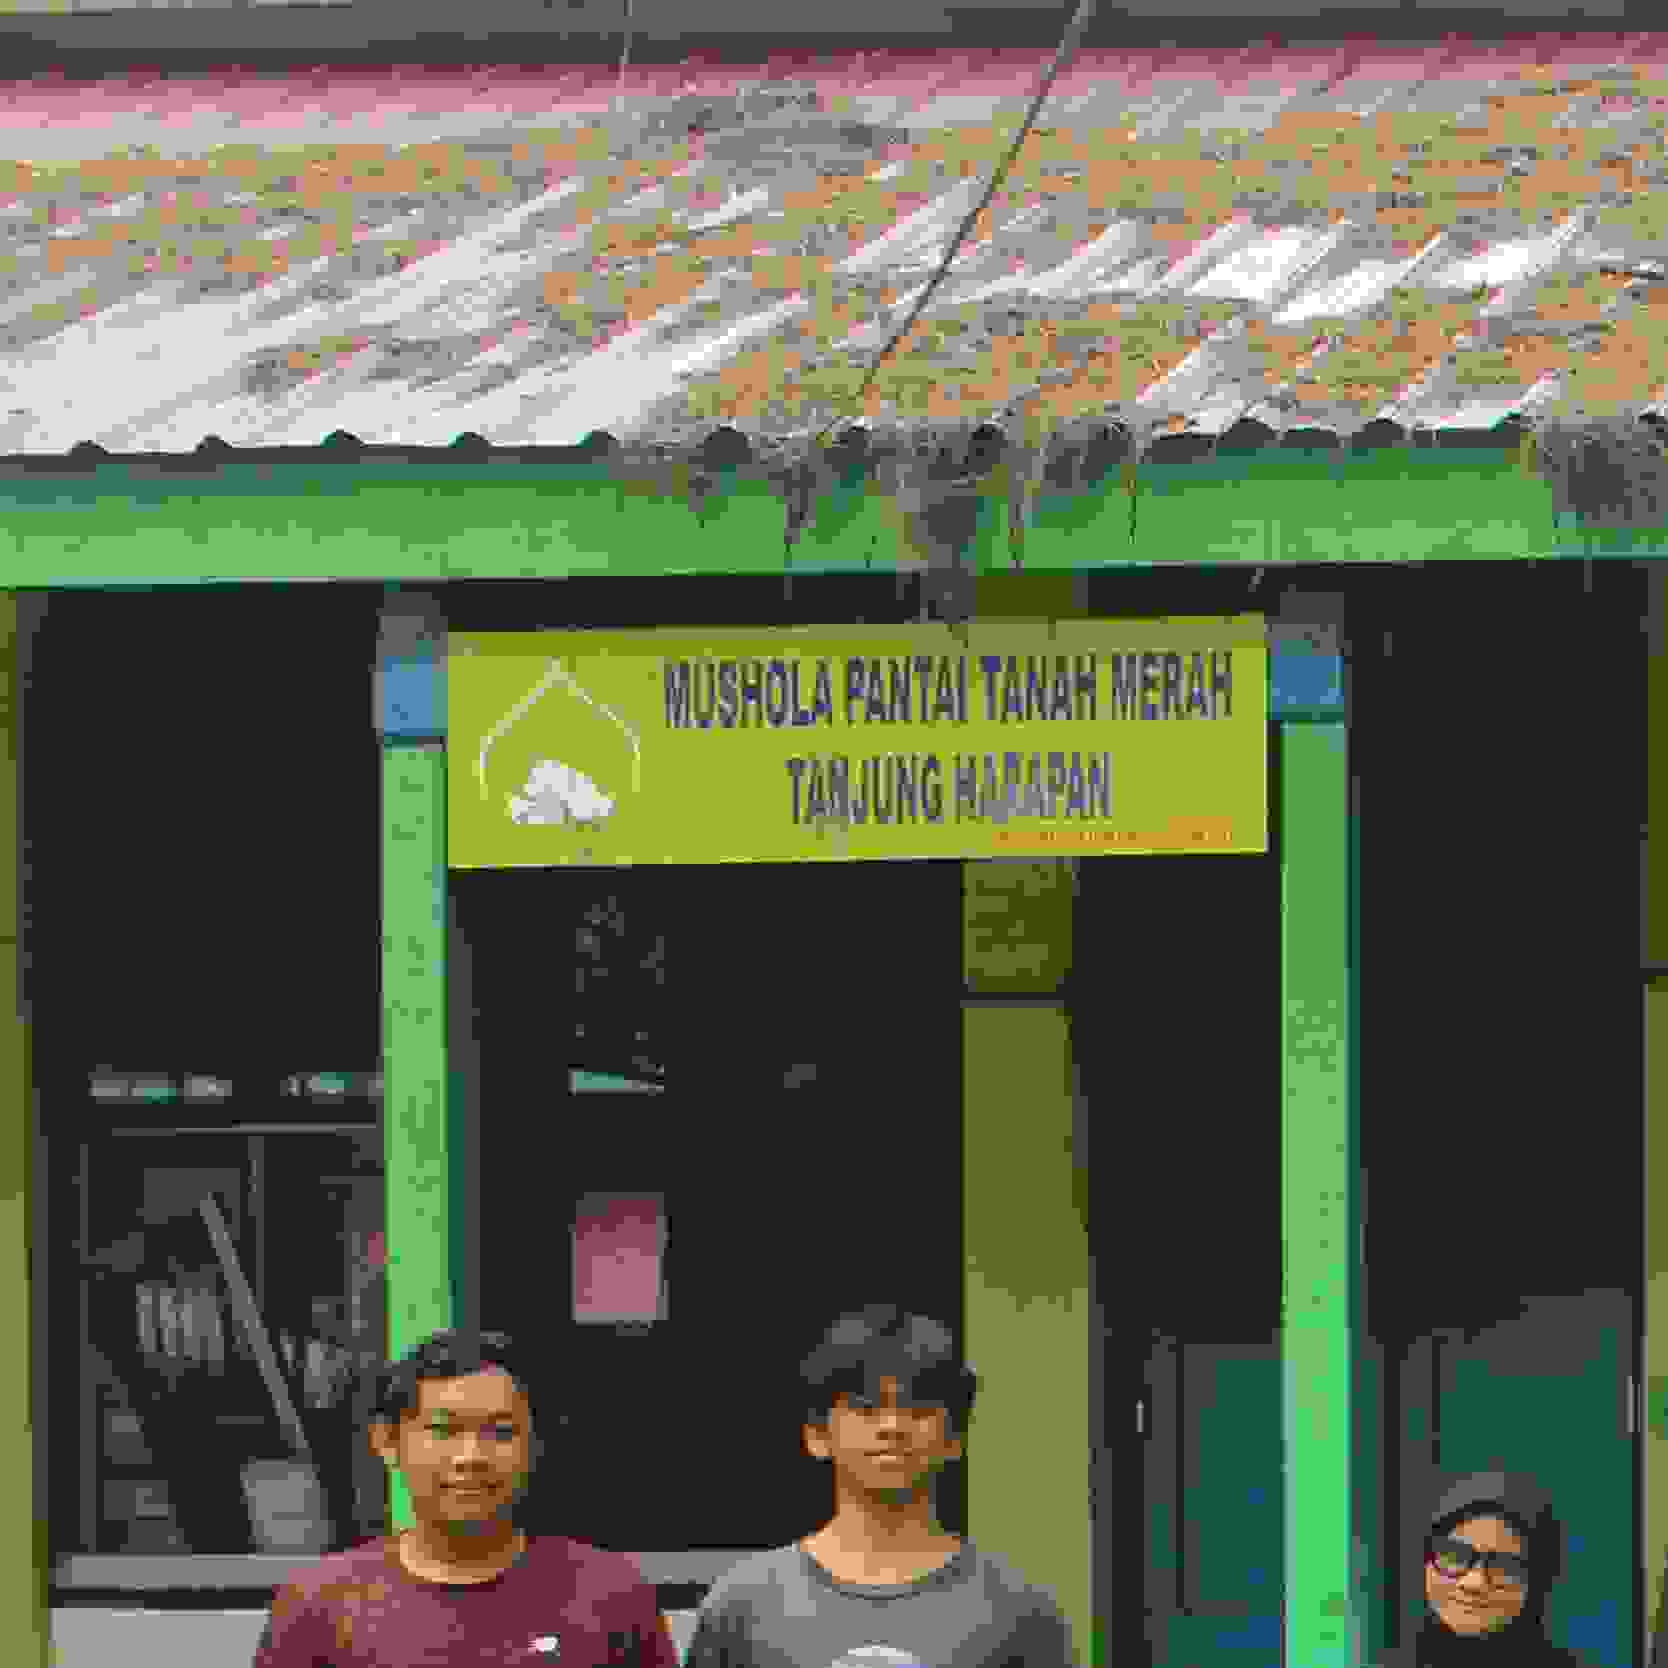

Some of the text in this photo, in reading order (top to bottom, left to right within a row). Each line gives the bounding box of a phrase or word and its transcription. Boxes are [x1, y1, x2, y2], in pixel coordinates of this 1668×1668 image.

[664, 652, 1233, 728] MUSHOLA PANTAI TANAH MERAH
[784, 752, 1112, 824] TANJUNG HARAPAN
